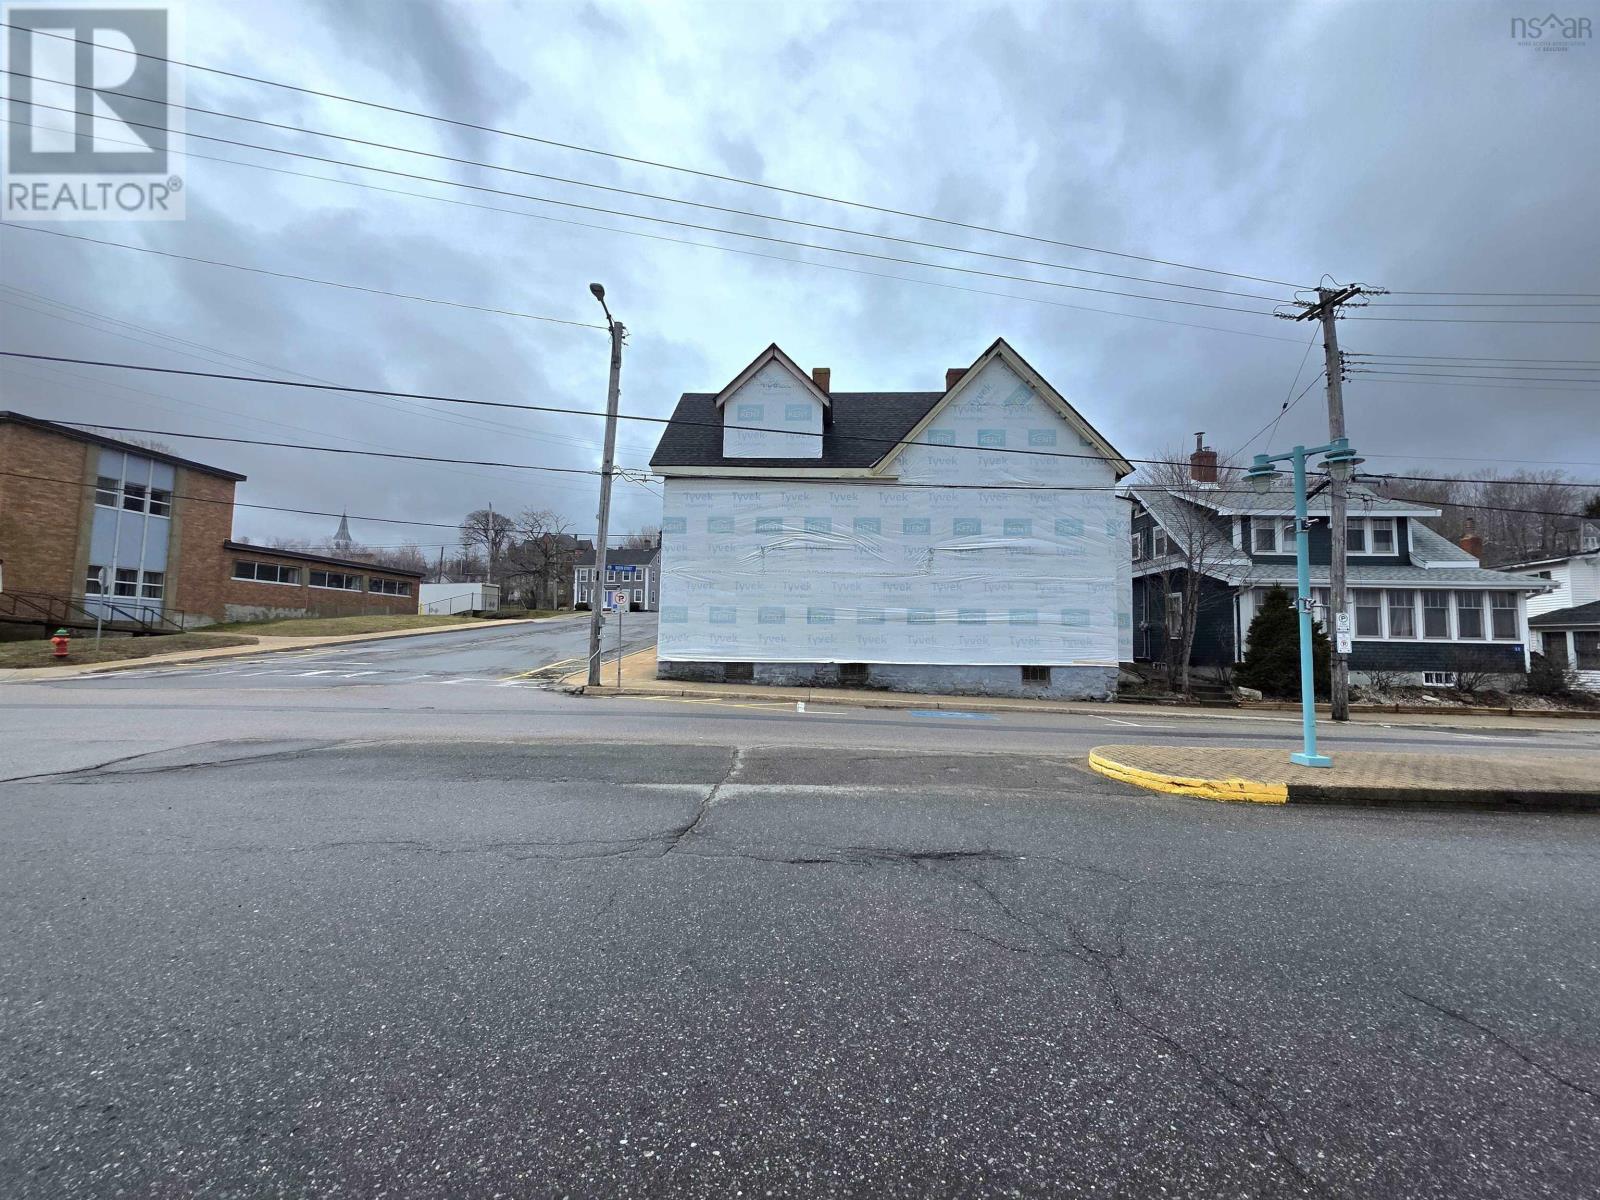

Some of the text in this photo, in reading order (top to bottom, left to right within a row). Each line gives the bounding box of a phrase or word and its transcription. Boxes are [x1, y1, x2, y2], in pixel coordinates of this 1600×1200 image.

[928, 455, 959, 467] Tyvek
[978, 455, 1008, 467] Tyvek
[685, 491, 713, 502] Tyvek
[732, 491, 761, 502] Tyvek
[781, 491, 810, 502] Tyvek
[830, 491, 858, 503] Tyvek
[879, 491, 910, 503] Tyvek
[928, 491, 959, 503] Tyvek
[977, 492, 1010, 503] Tyvek
[661, 543, 688, 553] yvek
[707, 542, 737, 553] Tyvek
[783, 581, 811, 592] Tyvek
[832, 581, 863, 592] Tyvek
[881, 581, 912, 592] Tyvek
[931, 581, 962, 592] Tyvek
[984, 581, 1014, 593] Tyvek
[661, 632, 689, 643] Tyvek
[710, 632, 737, 643] Tyvek
[758, 632, 786, 644] Tyvek
[808, 632, 836, 645] Tyvek
[857, 632, 888, 645] Tyvek
[1009, 635, 1041, 648] Tyvek
